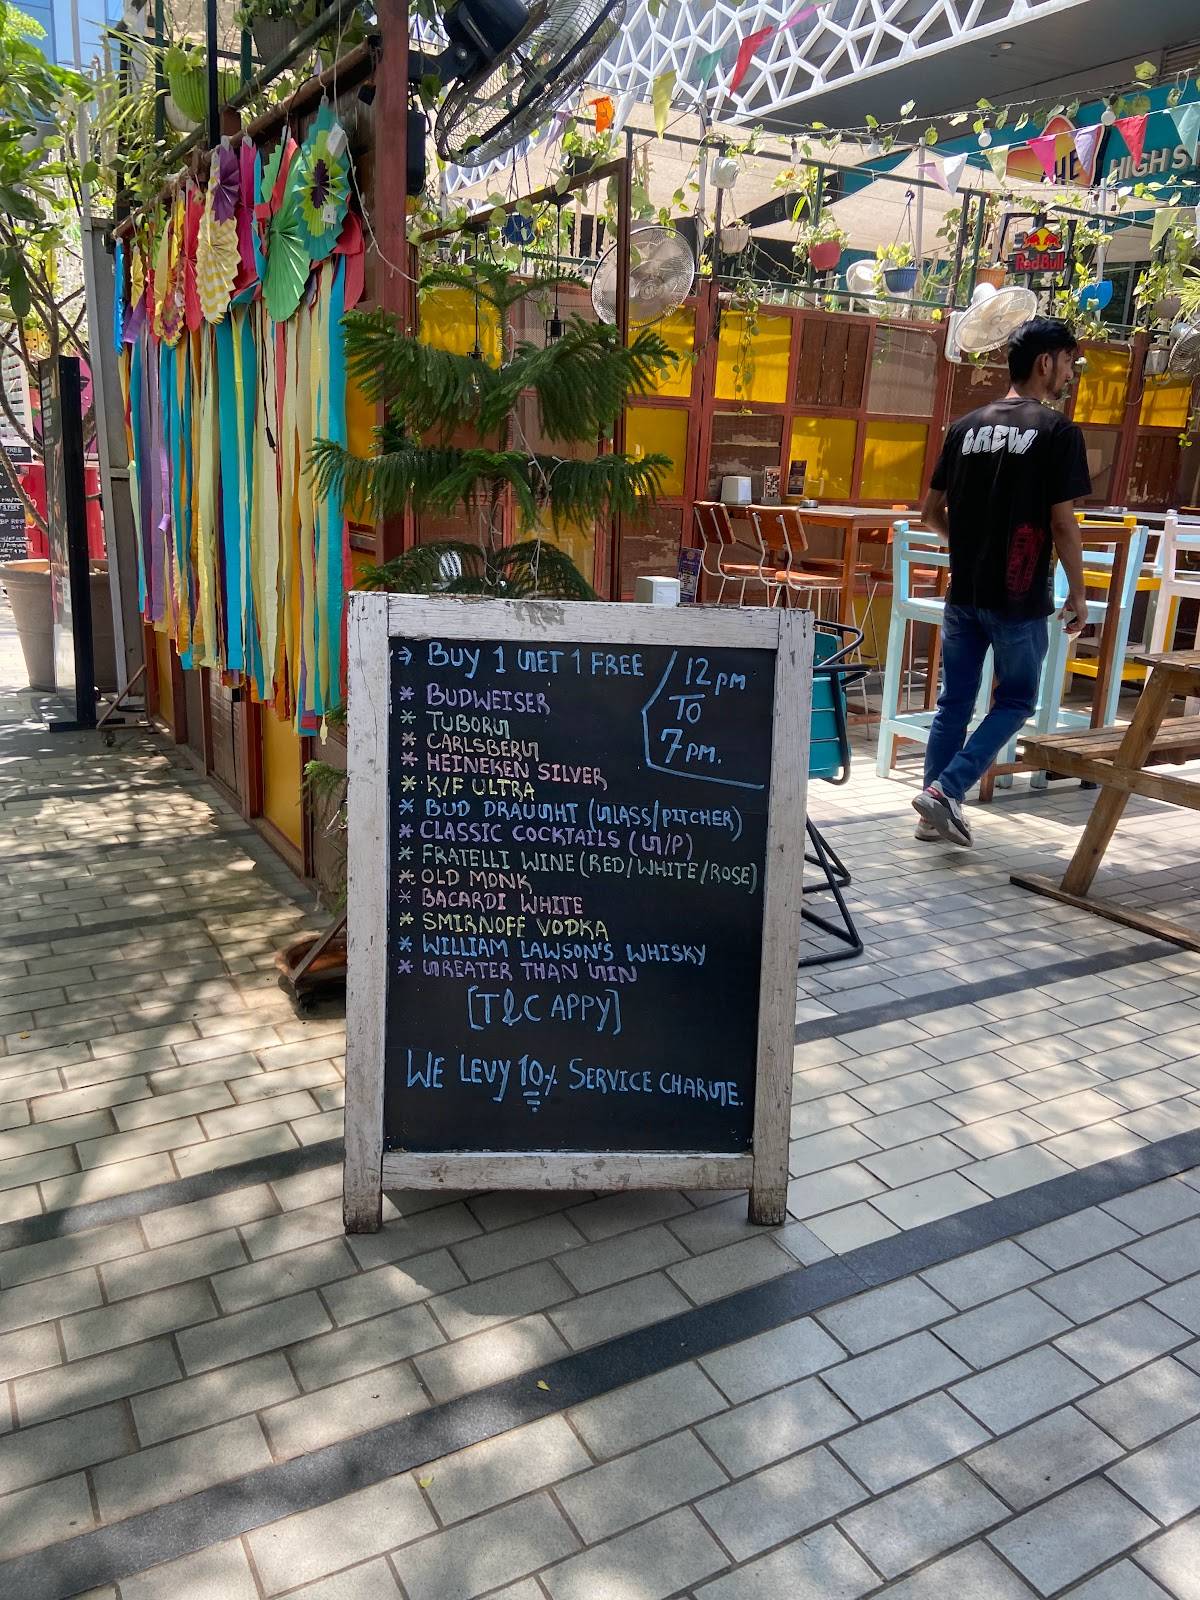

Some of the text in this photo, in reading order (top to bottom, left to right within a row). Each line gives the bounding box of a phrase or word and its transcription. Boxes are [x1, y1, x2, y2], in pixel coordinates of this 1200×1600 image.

[1109, 140, 1200, 180] HIGH S
[1015, 252, 1065, 270] Red Bull
[493, 646, 507, 674] 1
[571, 649, 581, 675] 1
[591, 652, 645, 677] FREE
[684, 657, 712, 686] 12
[426, 682, 551, 715] BUDWEISER
[426, 710, 510, 740] TUBORG
[426, 732, 540, 762] CARLSBERG
[660, 728, 684, 764] 7
[426, 753, 608, 791] HEINEKEN SILVER
[426, 775, 536, 802] K/F ULTRA
[426, 799, 471, 818] BUD
[420, 820, 502, 843] CLASSIC
[512, 825, 621, 849] COCKTAILS
[422, 847, 510, 871] FRATELLI
[421, 869, 533, 894] OLD MONK
[421, 888, 584, 915] BACARDI WHITE
[422, 912, 610, 941] SMIRNOFF VODKA
[421, 934, 707, 965] WILLIAM LAWSON'S WHISKY
[520, 962, 579, 983] THAN
[407, 1049, 446, 1089] WE
[460, 1054, 511, 1102] LEVY
[569, 1058, 652, 1095] SERVICE
